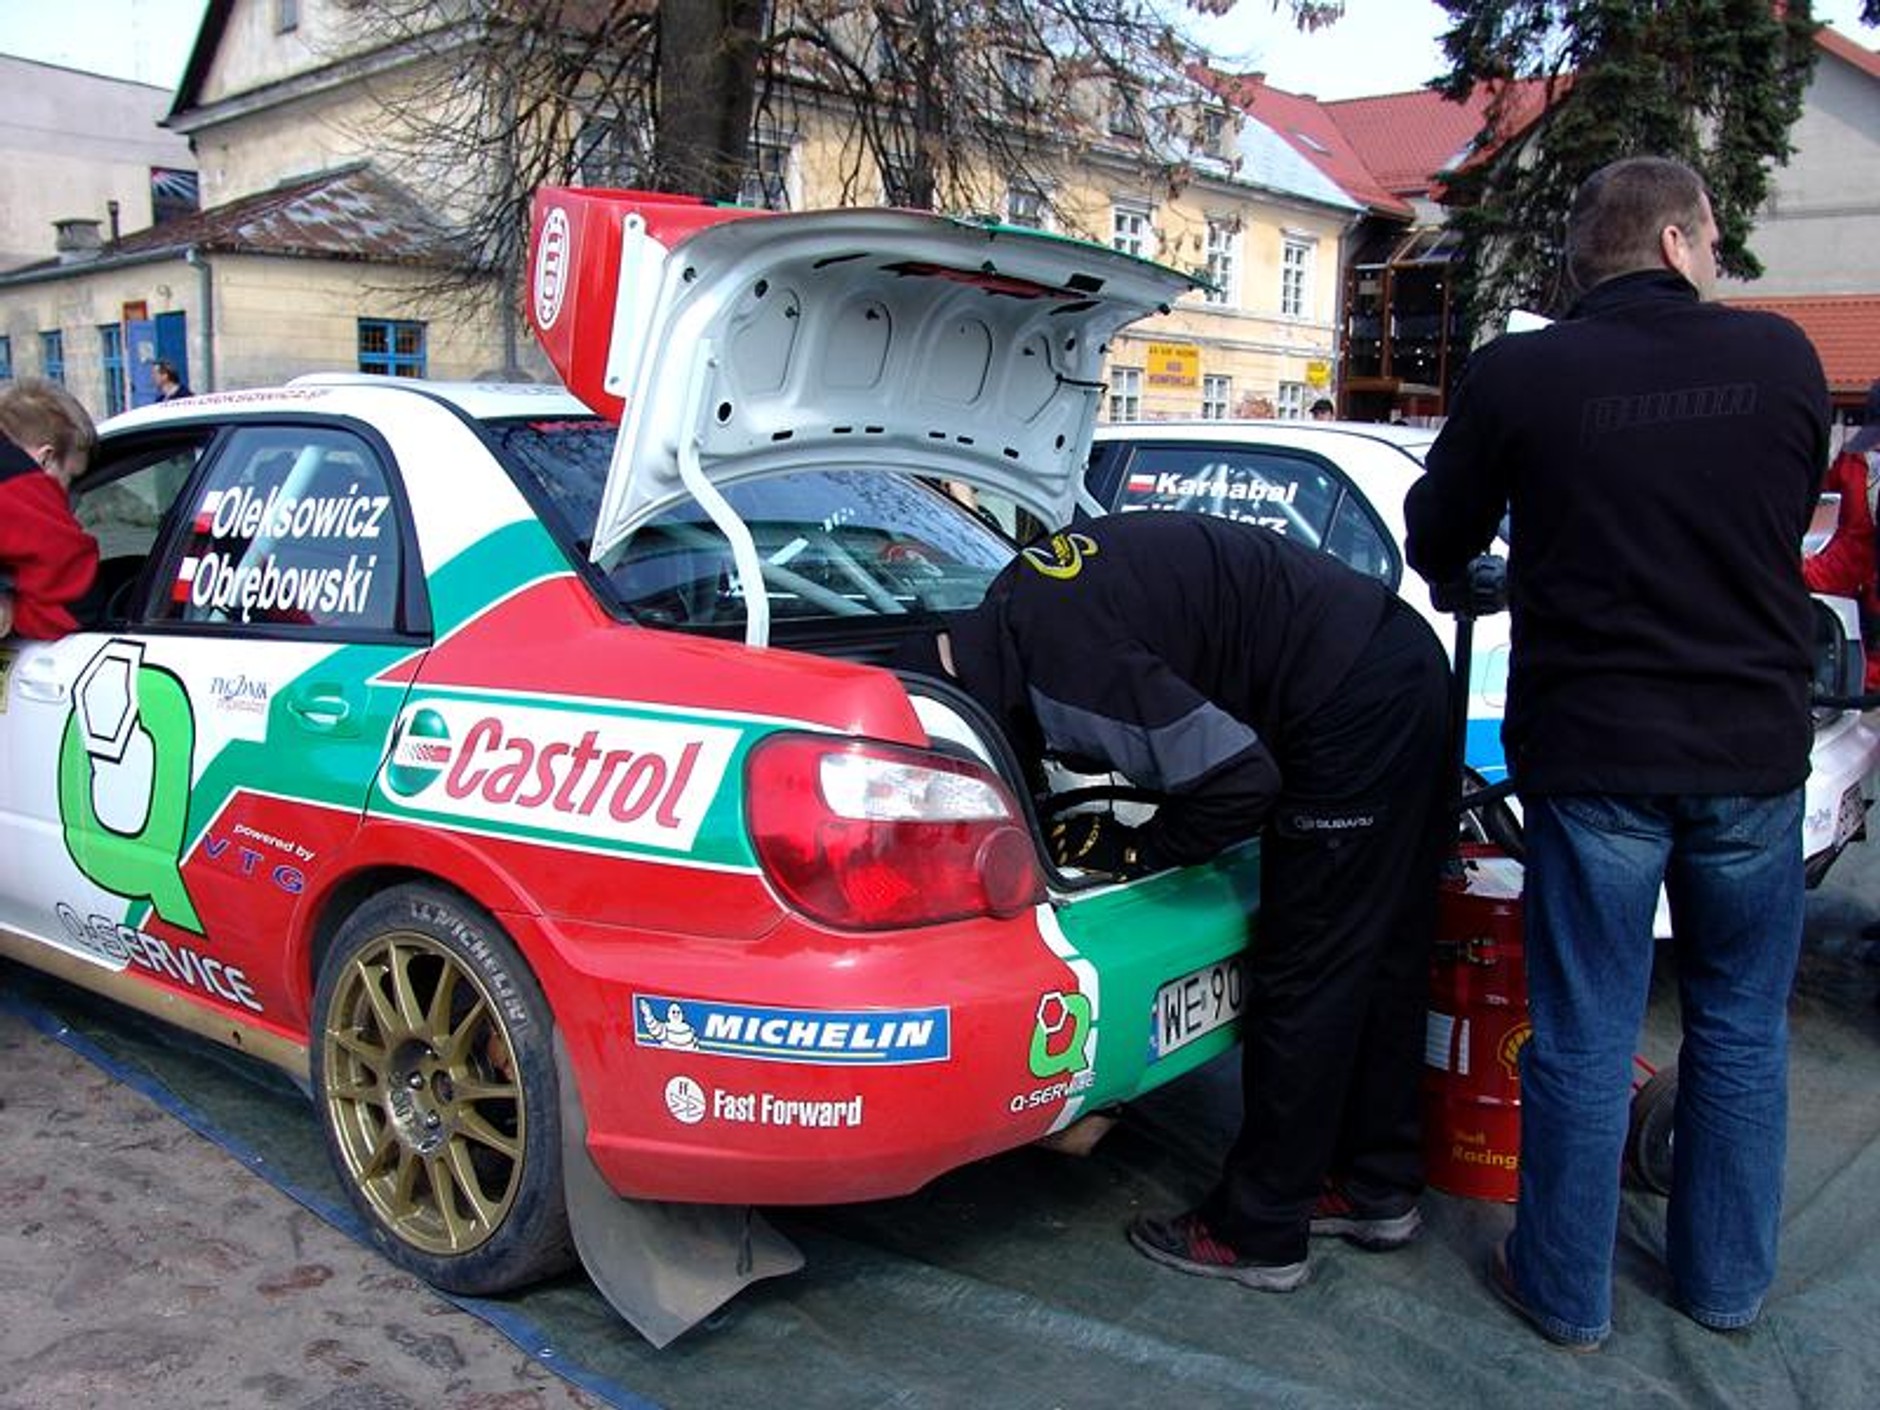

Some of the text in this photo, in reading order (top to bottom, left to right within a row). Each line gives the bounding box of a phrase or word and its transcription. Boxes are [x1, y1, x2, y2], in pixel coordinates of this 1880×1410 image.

[211, 484, 390, 538] Oleksowicz
[192, 552, 377, 624] Obrębowski
[445, 717, 703, 828] Castrol
[233, 823, 315, 862] powered by
[704, 1013, 934, 1049] MICHELIN
[713, 1088, 864, 1127] Fast Forward
